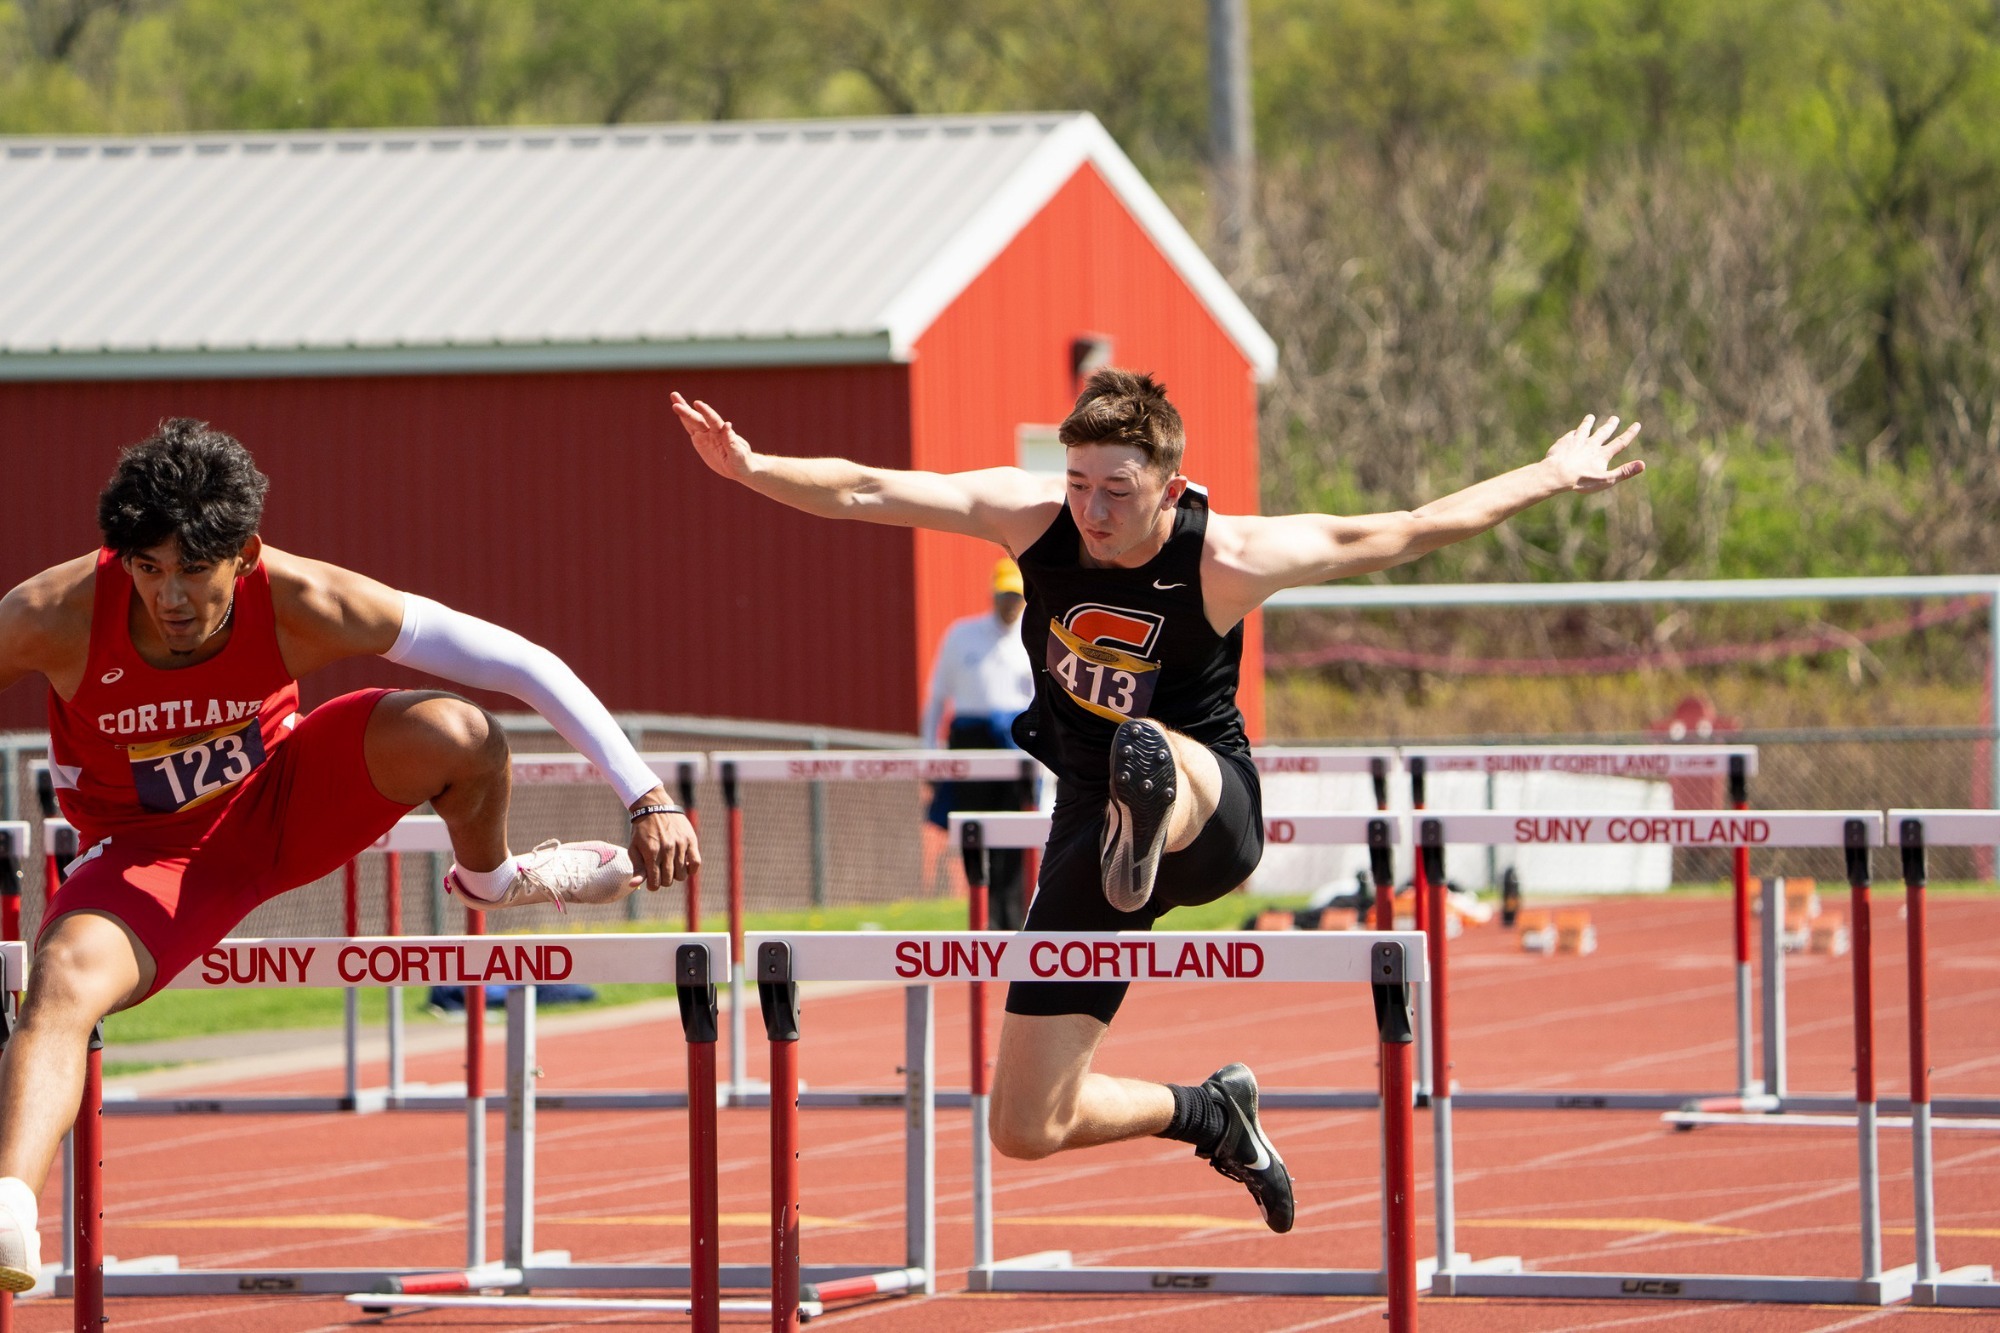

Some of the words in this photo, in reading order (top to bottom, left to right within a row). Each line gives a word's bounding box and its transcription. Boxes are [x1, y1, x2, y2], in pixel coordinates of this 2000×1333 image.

[1056, 652, 1137, 714] 413
[154, 734, 251, 804] 123
[788, 759, 843, 778] SUNY
[852, 759, 971, 778] CORTLAND
[1484, 755, 1544, 774] SUNY
[1549, 755, 1670, 776] CORTLAND
[1514, 818, 1592, 843] SUNY
[1607, 818, 1770, 844] CORTLAND
[201, 946, 316, 985] SUNY
[337, 945, 573, 983] CORTLAND
[895, 940, 1008, 978] SUNY
[1029, 941, 1264, 978] CORTLAND
[1151, 1274, 1210, 1289] UCS
[1621, 1279, 1681, 1295] UCS
